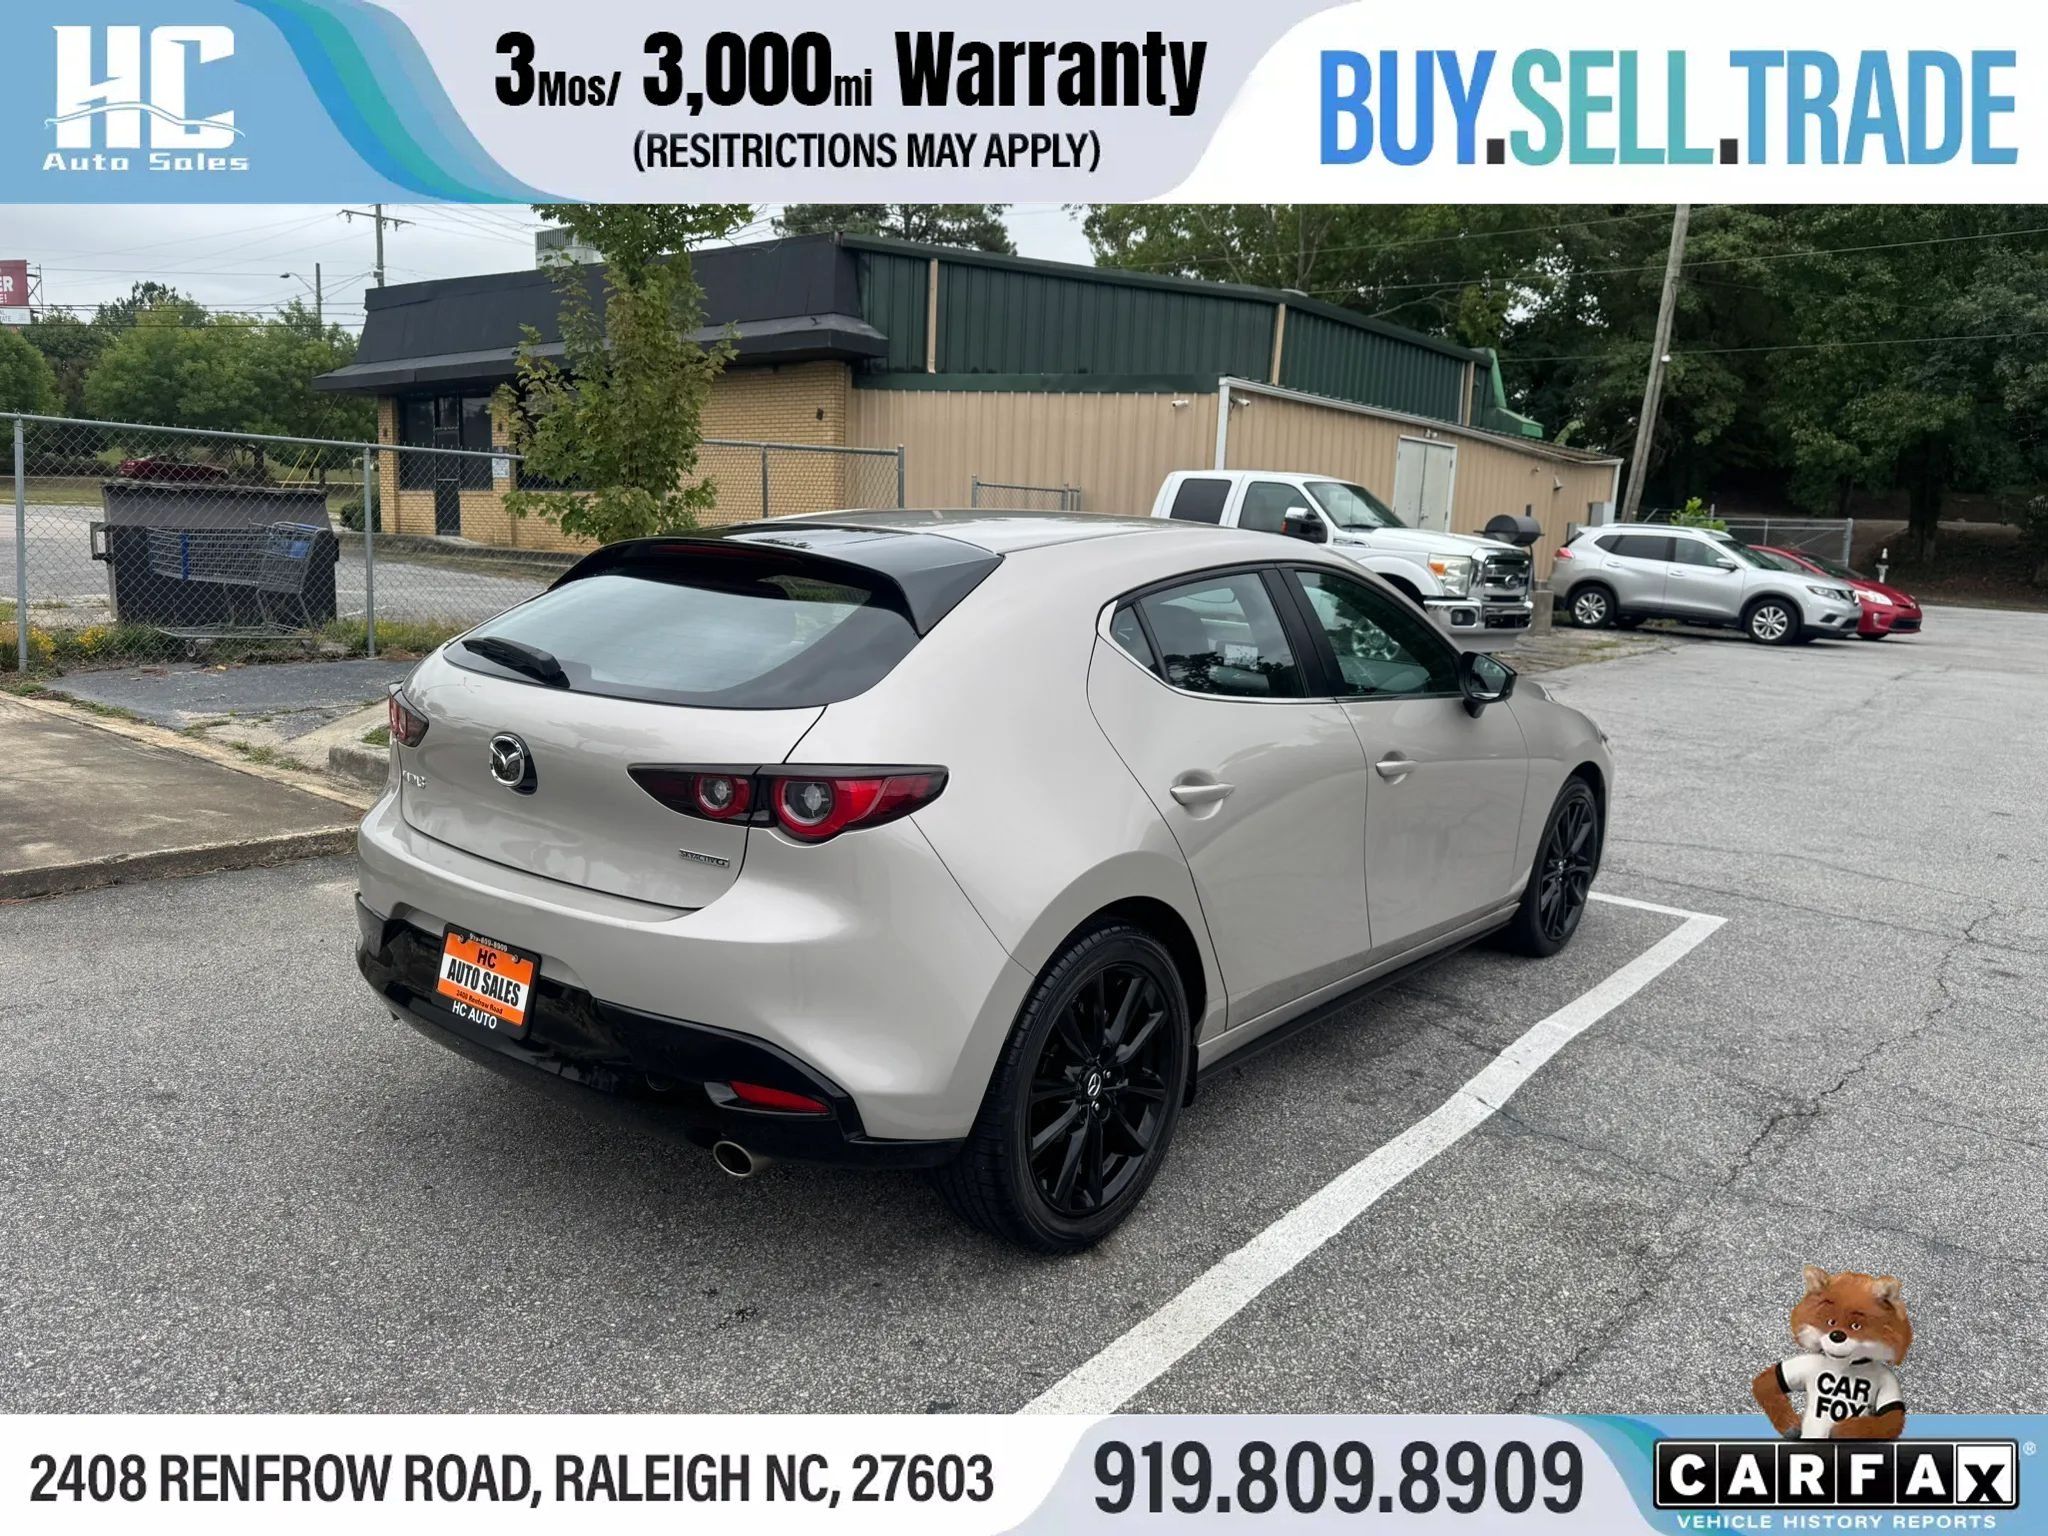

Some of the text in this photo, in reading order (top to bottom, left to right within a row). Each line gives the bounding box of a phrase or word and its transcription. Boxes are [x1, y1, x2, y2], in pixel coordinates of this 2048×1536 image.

[477, 948, 497, 968] HC
[446, 958, 521, 1007] AUTO SALES
[451, 1000, 498, 1030] HC AUTO
[489, 1003, 504, 1015] Road
